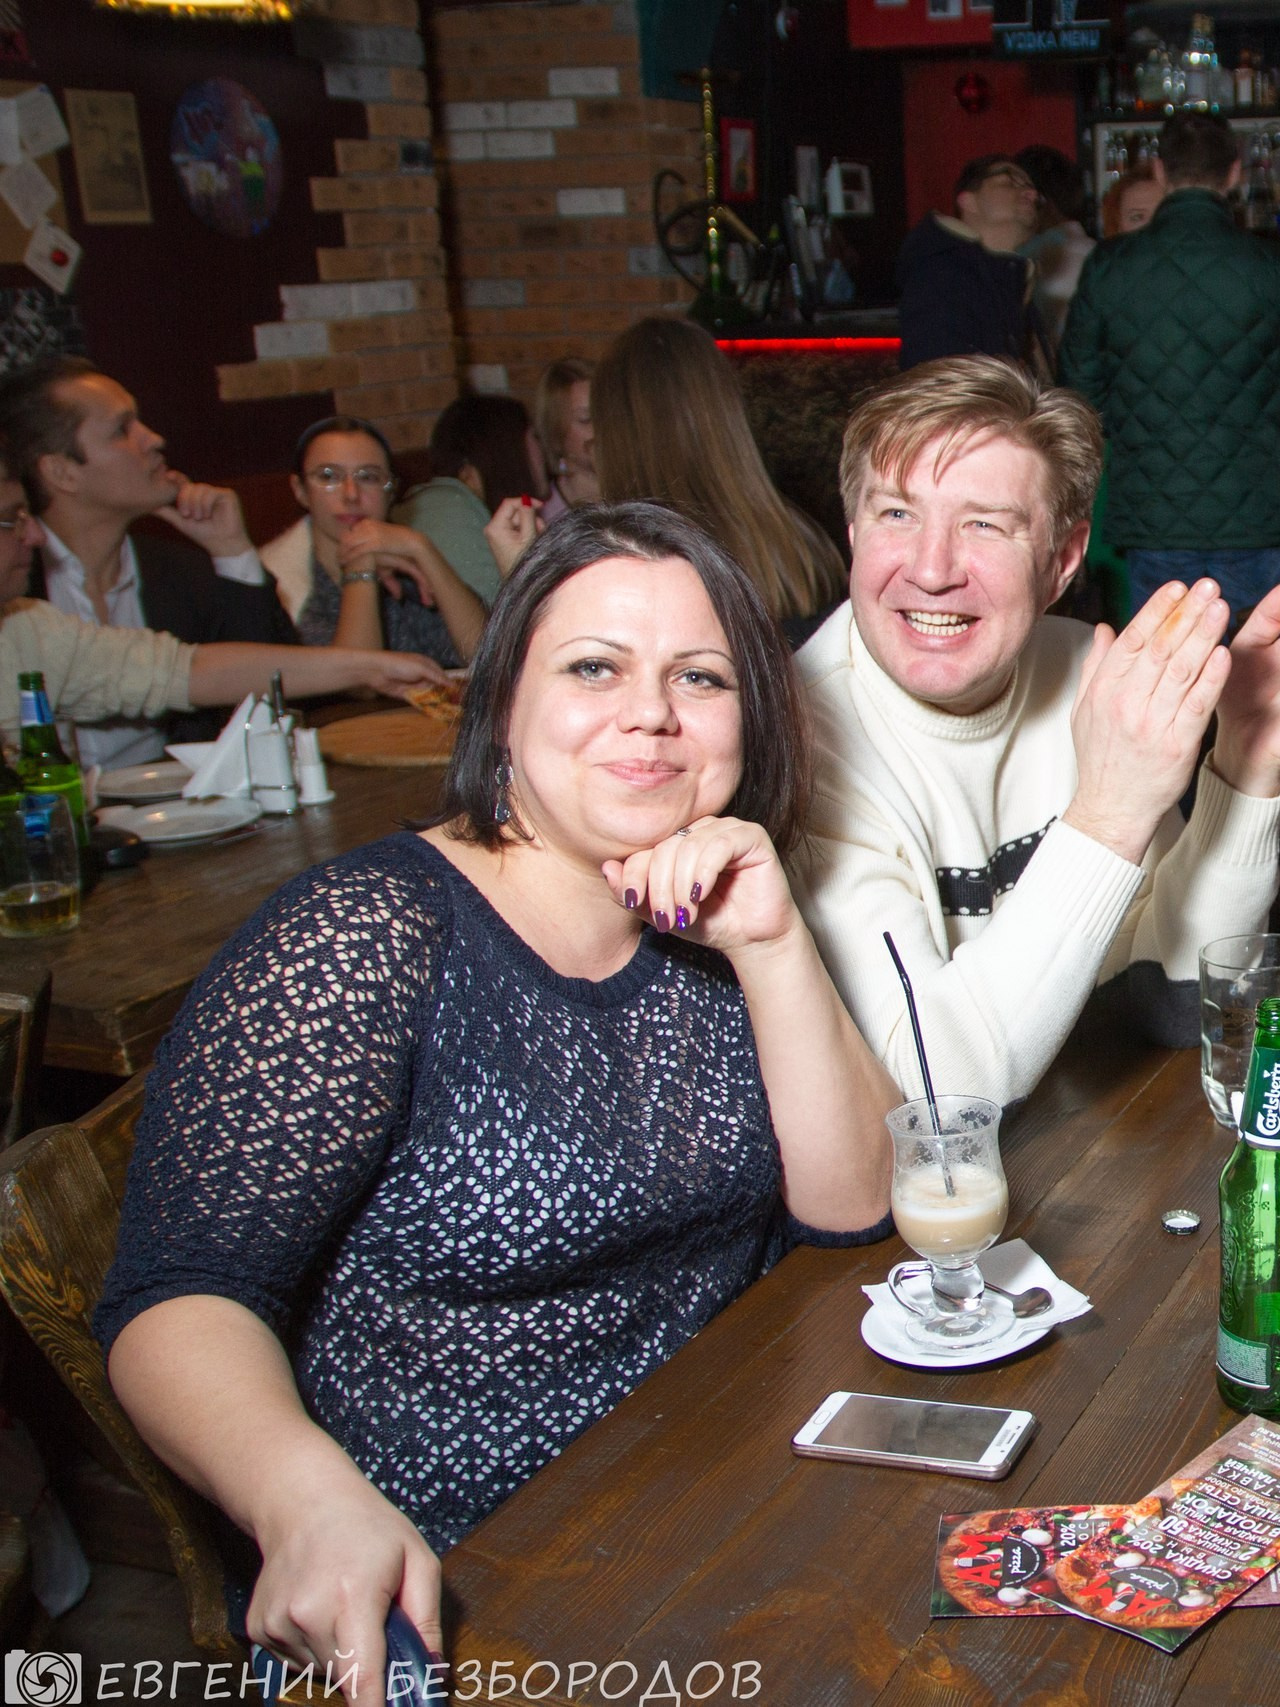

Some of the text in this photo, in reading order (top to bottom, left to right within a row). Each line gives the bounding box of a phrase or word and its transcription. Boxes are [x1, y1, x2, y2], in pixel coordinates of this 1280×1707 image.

[1003, 29, 1101, 51] VODKA MENU
[1222, 1458, 1277, 1483] ЛАНЧЕЙ
[1194, 1481, 1243, 1504] СЕТЫ:
[1229, 1486, 1246, 1494] ДО
[1171, 1501, 1211, 1522] ПИЦЦА
[1179, 1492, 1271, 1533] ПОДАРОК
[1060, 1523, 1076, 1545] 20%
[1186, 1524, 1242, 1550] СКИДКА
[1223, 1525, 1273, 1544] КАЖДАЯ
[1126, 1534, 1232, 1579] СКИДКА 20%
[1137, 1528, 1242, 1571] НА ВЫНОС
[1195, 1538, 1234, 1556] ПИЦЦА
[1007, 1546, 1025, 1573] pizza
[1127, 1572, 1169, 1590] pizza
